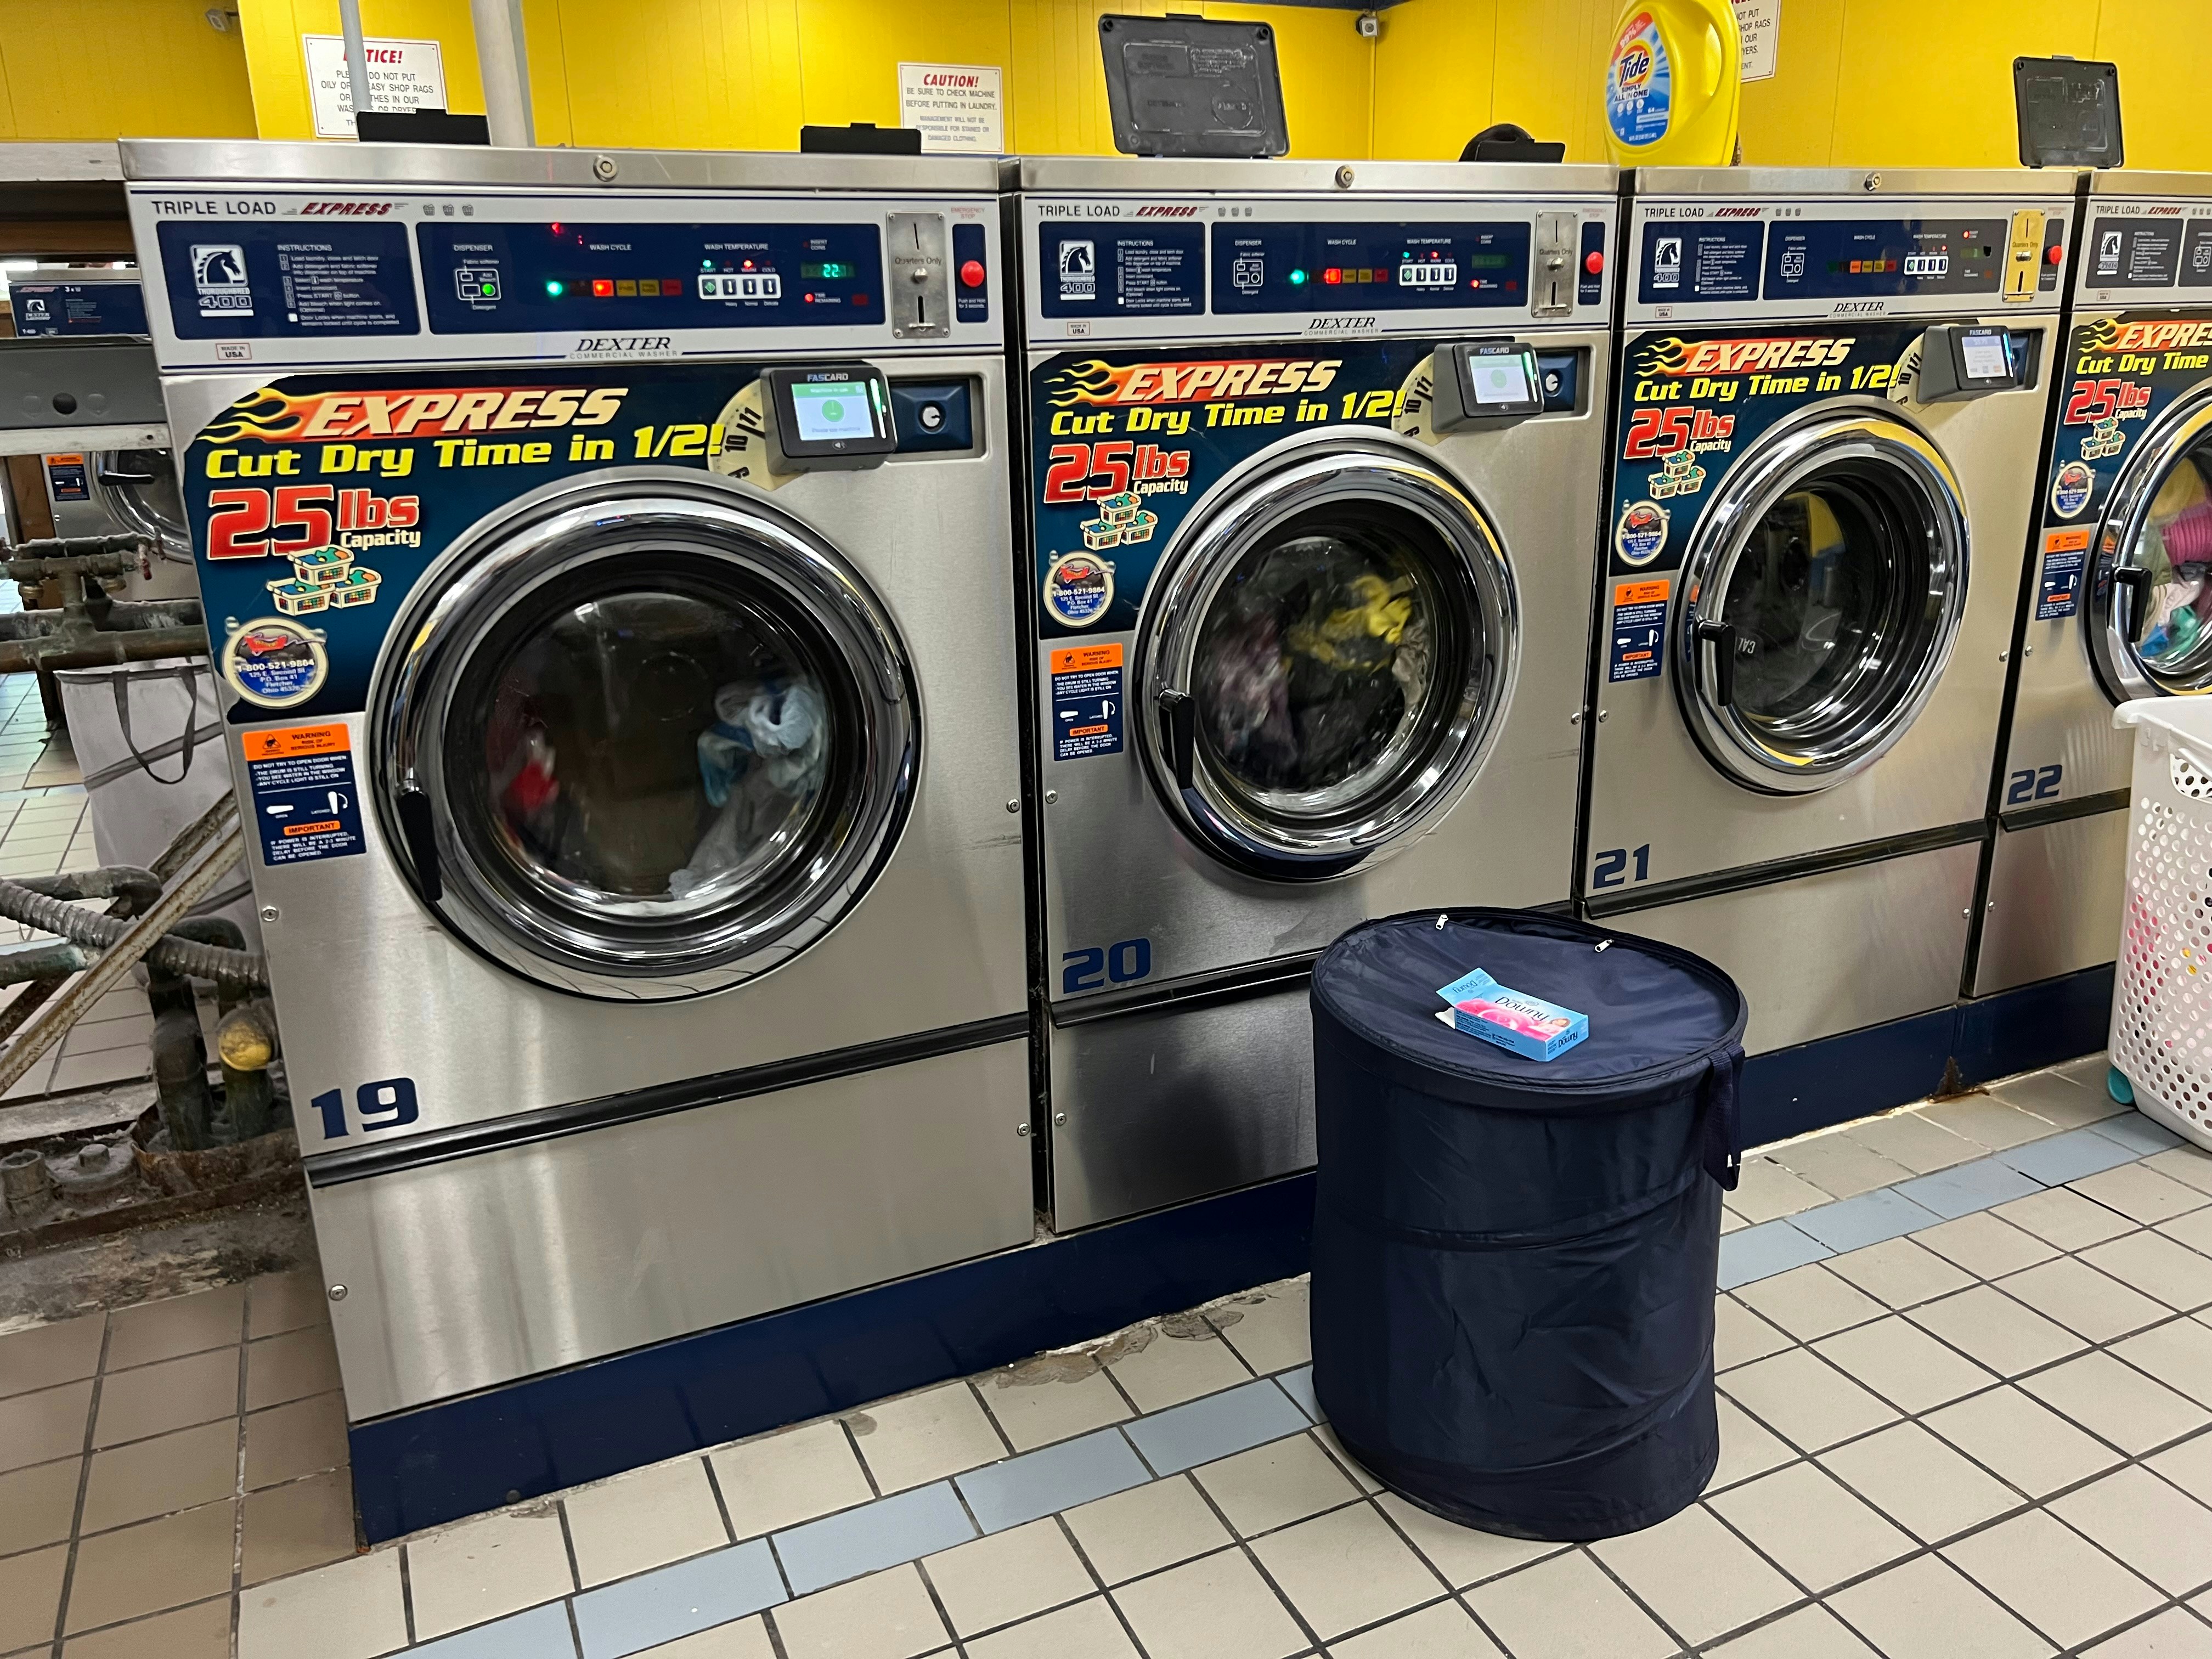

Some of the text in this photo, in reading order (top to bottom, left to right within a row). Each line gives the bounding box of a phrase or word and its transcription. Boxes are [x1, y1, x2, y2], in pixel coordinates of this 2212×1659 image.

[1748, 8, 1759, 18] PUT
[1755, 18, 1771, 29] RAGS
[1745, 33, 1757, 43] OUR
[369, 71, 416, 81] DO NOT PUT
[1619, 52, 1650, 88] Tide
[321, 80, 337, 89] OILY
[389, 83, 410, 92] SHOP
[413, 84, 434, 93] RAGS
[923, 74, 979, 88] CAUTION!
[1622, 83, 1641, 93] SIMPLY
[340, 93, 419, 104] OR IN OUR
[946, 89, 967, 97] CHECK
[969, 90, 995, 99] MACHINE
[1614, 89, 1649, 103] ALL IN ONE
[906, 100, 930, 108] BEFORE
[151, 201, 393, 216] TRIPLE LOAD EXPRESS
[1038, 205, 1198, 217] TRIPLE LOAD EXPRESS
[1645, 207, 1761, 218] TRIPLE LOAD EXPRESS
[2096, 206, 2119, 214] TRIPLE
[2121, 206, 2140, 215] LOAD
[1561, 248, 1573, 257] Only
[926, 257, 942, 266] Only
[823, 264, 839, 278] 22
[1653, 273, 1679, 282] 400
[1060, 282, 1096, 294] 400
[198, 295, 252, 309] 400
[1833, 302, 1884, 312] DEXTER
[1308, 316, 1375, 329] DEXTER
[2117, 323, 2212, 350] EXPRE
[575, 337, 671, 352] DEXTER
[1480, 347, 1510, 355] FASCARD
[570, 352, 633, 360] COMMERCIAL
[1685, 338, 1856, 373] EXPRESS
[1910, 352, 1922, 367] 11
[2076, 352, 2209, 375] Cut Dry Time
[806, 373, 849, 382] FASCARD
[1117, 360, 1342, 402] EXPRESS
[1417, 376, 1434, 392] 11
[1634, 363, 1901, 402] Cut Dry Time in 1/2!
[1898, 373, 1912, 386] 10
[1404, 399, 1422, 414] 10
[2063, 379, 2152, 425] 25 lbs
[303, 388, 629, 437] EXPRESS
[739, 406, 763, 426] 11
[1050, 390, 1407, 436] Cut Dry Time in 1/2!
[2115, 408, 2148, 422] Capacity
[1623, 406, 1735, 460] 25 lbs
[206, 424, 726, 478] Cut Dry Time in 1/2!
[724, 435, 748, 453] 10
[1690, 439, 1731, 453] Capacity
[1043, 440, 1190, 504] 25 lbs
[1133, 479, 1189, 497] Capacity
[206, 484, 419, 560] 25 lbs
[341, 529, 421, 550] Capacity
[1738, 637, 1756, 654] CAL
[292, 731, 331, 740] WARNING
[1073, 726, 1105, 735] IMPORTANT
[2007, 764, 2063, 805] 22
[289, 823, 336, 833] IMPORTANT
[1593, 843, 1650, 889] 21
[1062, 938, 1151, 994] 20
[1452, 980, 1478, 994] Downy
[1494, 996, 1550, 1022] Downy
[1558, 1031, 1578, 1048] Downy
[311, 1077, 419, 1139] 19
